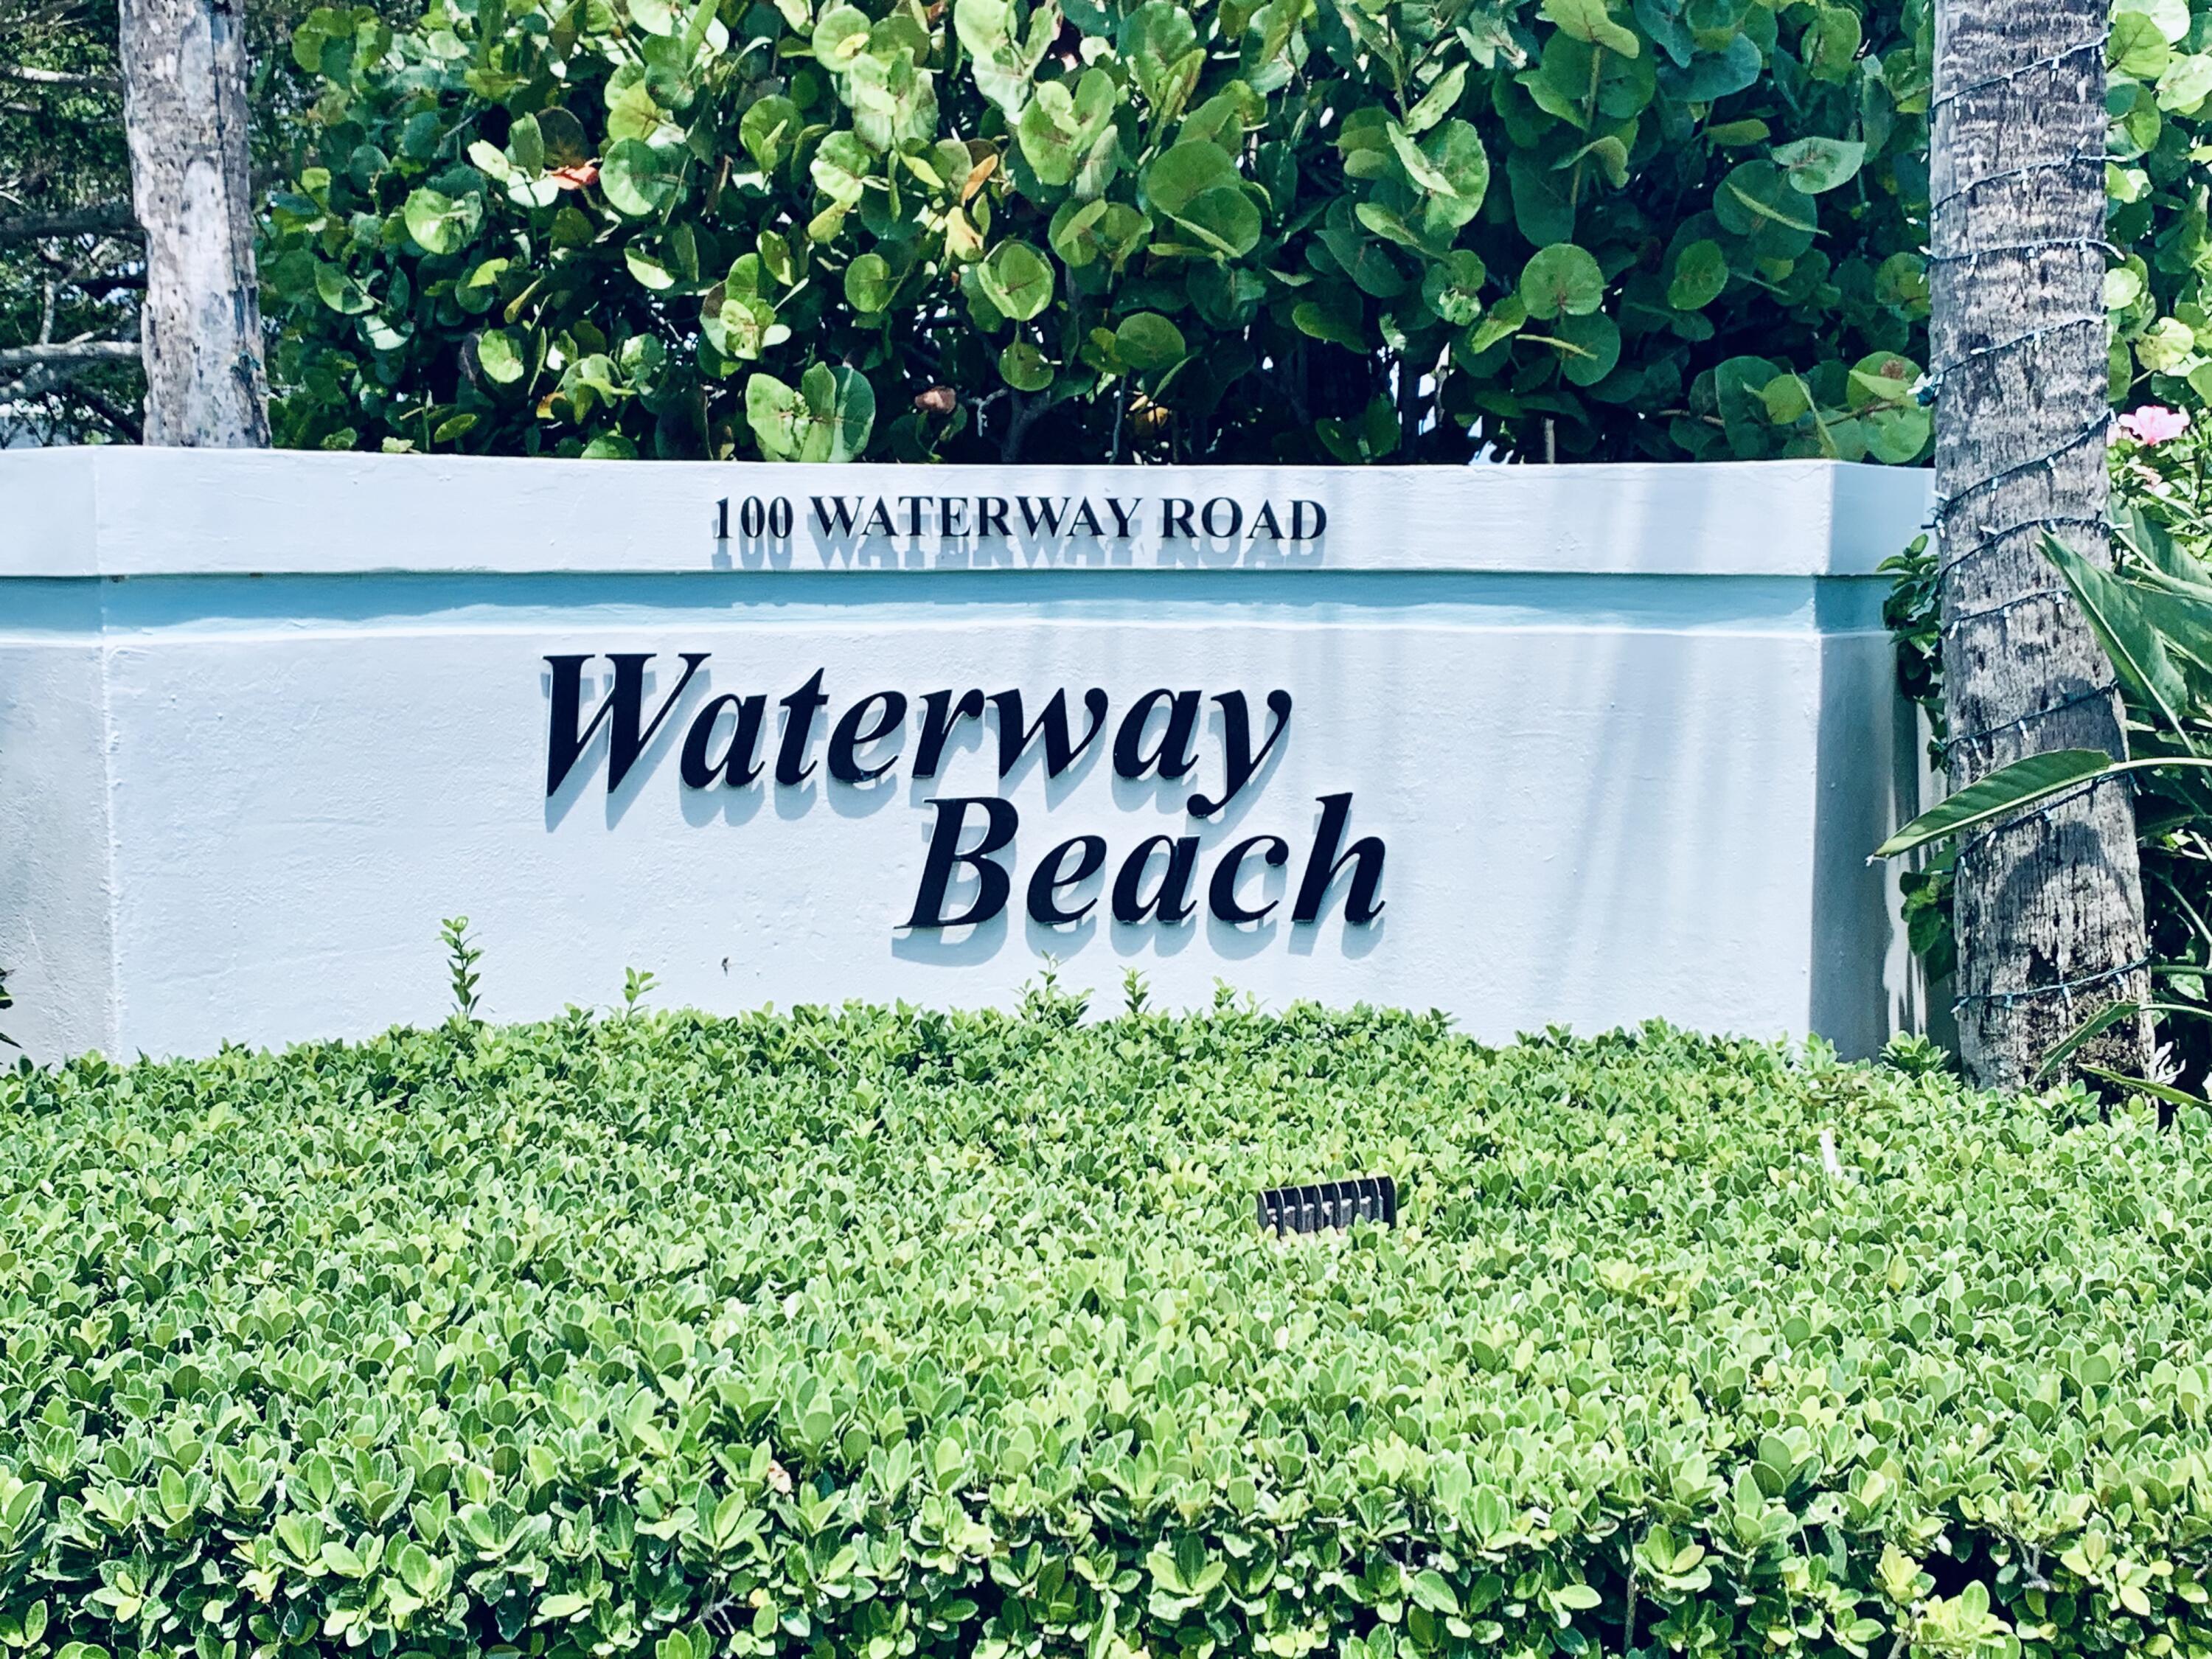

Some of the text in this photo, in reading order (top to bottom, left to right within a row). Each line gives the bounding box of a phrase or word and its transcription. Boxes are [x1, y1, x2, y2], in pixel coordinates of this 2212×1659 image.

[714, 496, 1329, 540] 100 WATERWAY ROAD
[543, 653, 1293, 821] Waterway
[894, 793, 1387, 931] Beach
